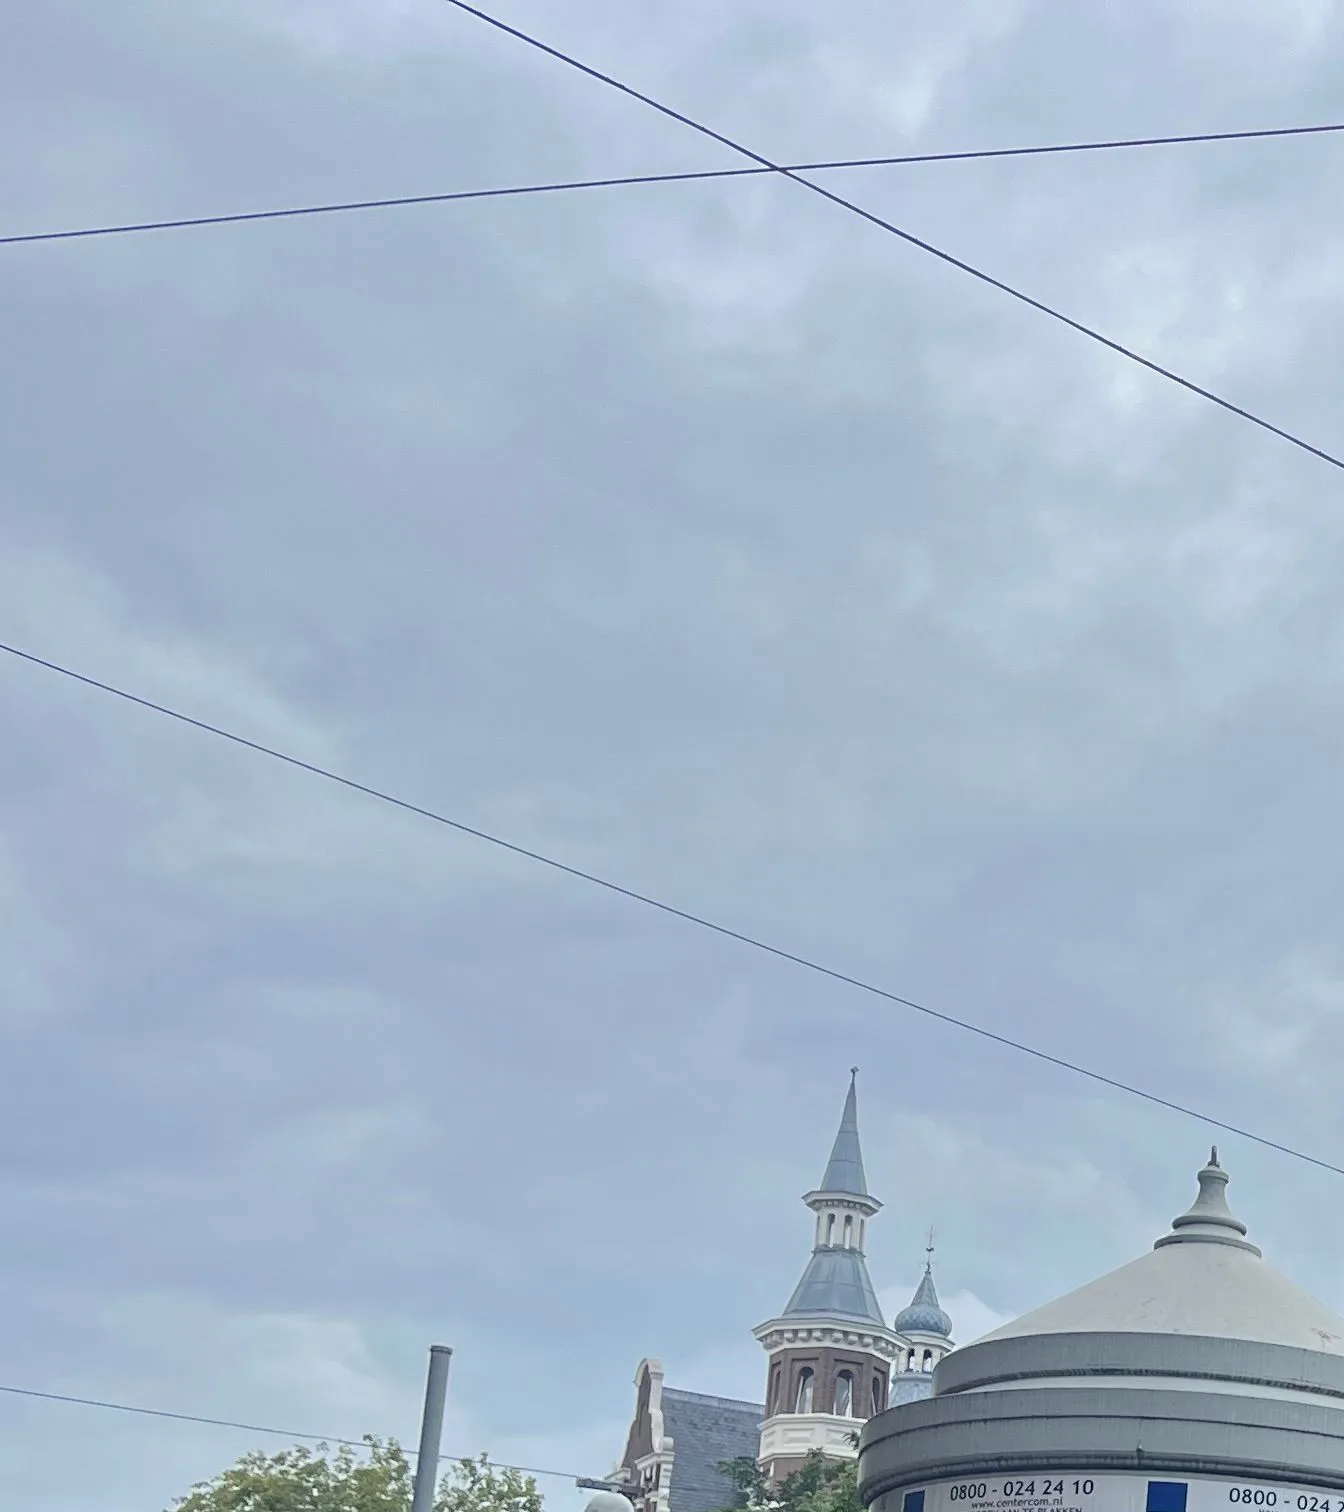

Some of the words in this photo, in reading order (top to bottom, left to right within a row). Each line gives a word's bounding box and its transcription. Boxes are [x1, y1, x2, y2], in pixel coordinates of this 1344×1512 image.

[950, 1483, 986, 1500] 0800
[1003, 1480, 1035, 1497] 024
[1042, 1480, 1063, 1496] 24
[1073, 1479, 1094, 1495] 10
[1229, 1487, 1277, 1506] 0800
[971, 1497, 1063, 1509] www.centercom.nl
